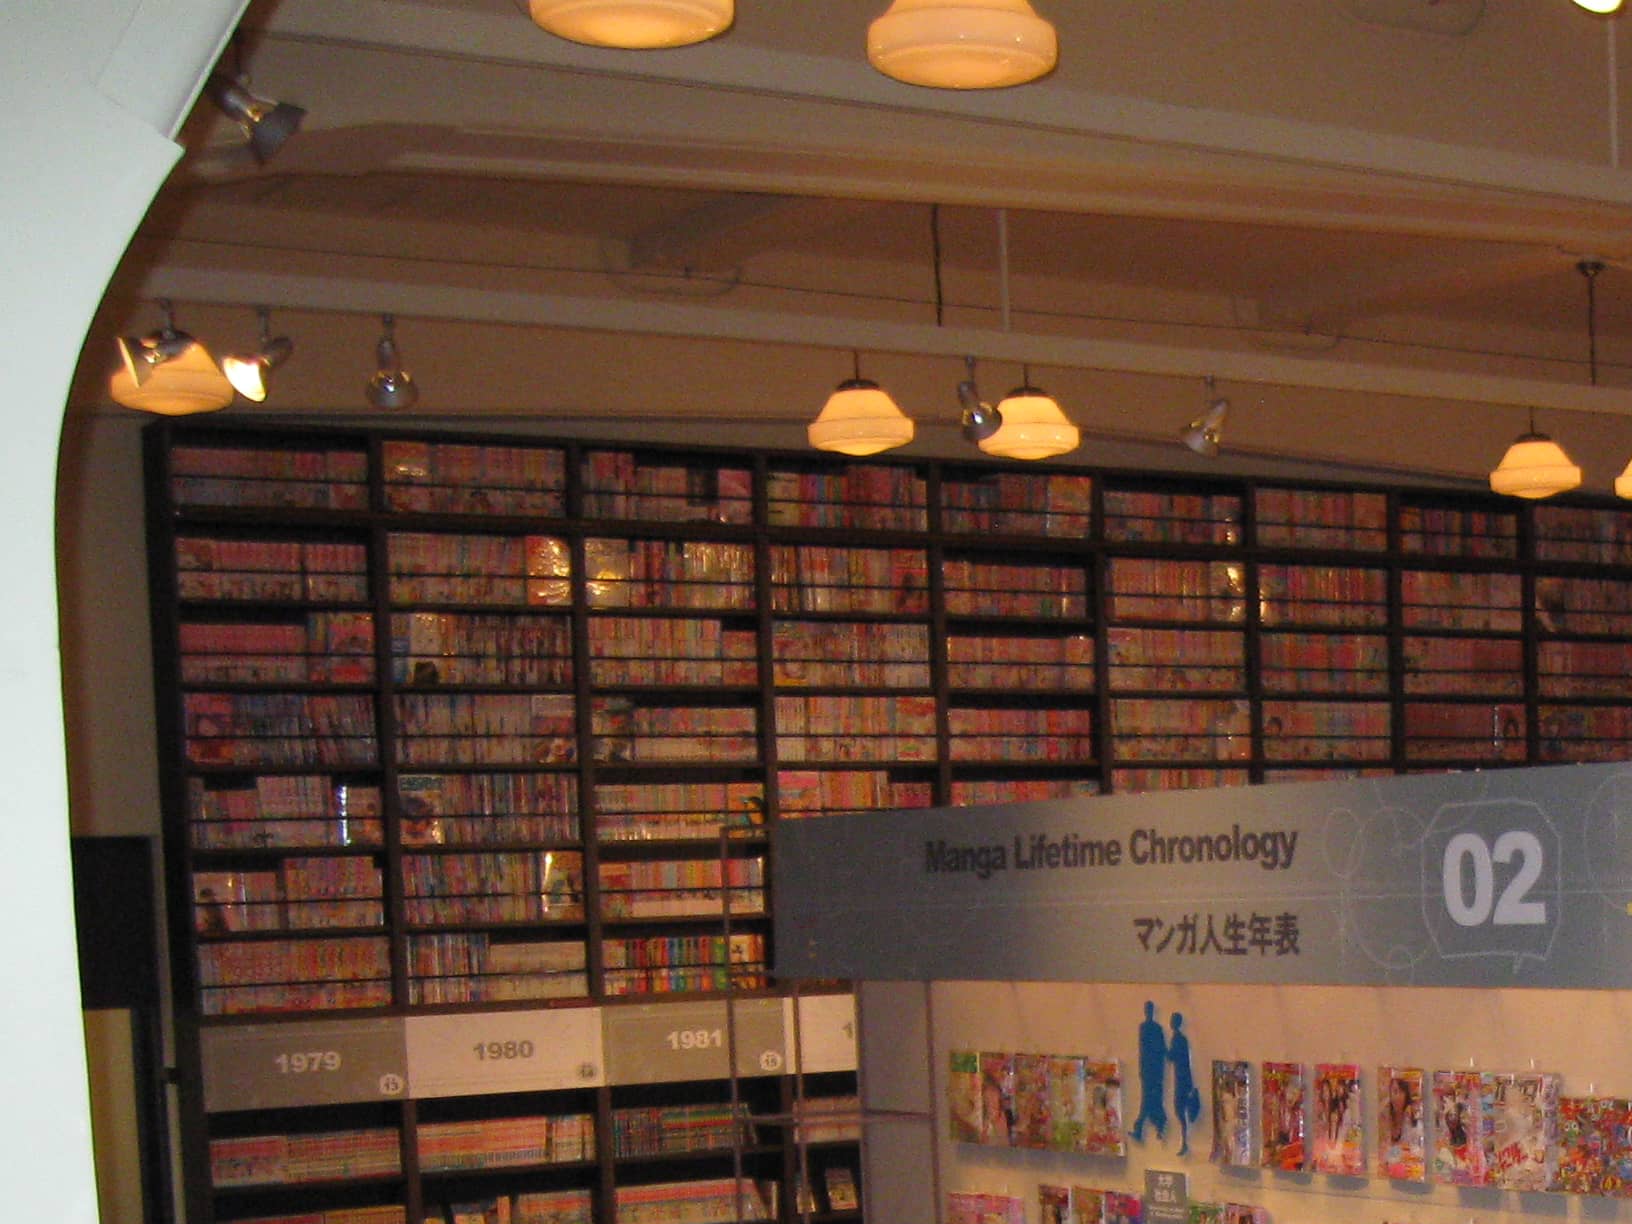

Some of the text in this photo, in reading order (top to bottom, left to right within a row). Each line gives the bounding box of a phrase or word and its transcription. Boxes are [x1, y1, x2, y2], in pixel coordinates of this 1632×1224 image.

[925, 823, 1298, 880] Manga Lifetime Chronology
[1441, 829, 1547, 927] 02
[1132, 912, 1301, 958] マンガ人生年表
[472, 1039, 534, 1062] 1980
[666, 1028, 723, 1051] 1981
[274, 1050, 342, 1074] 1979
